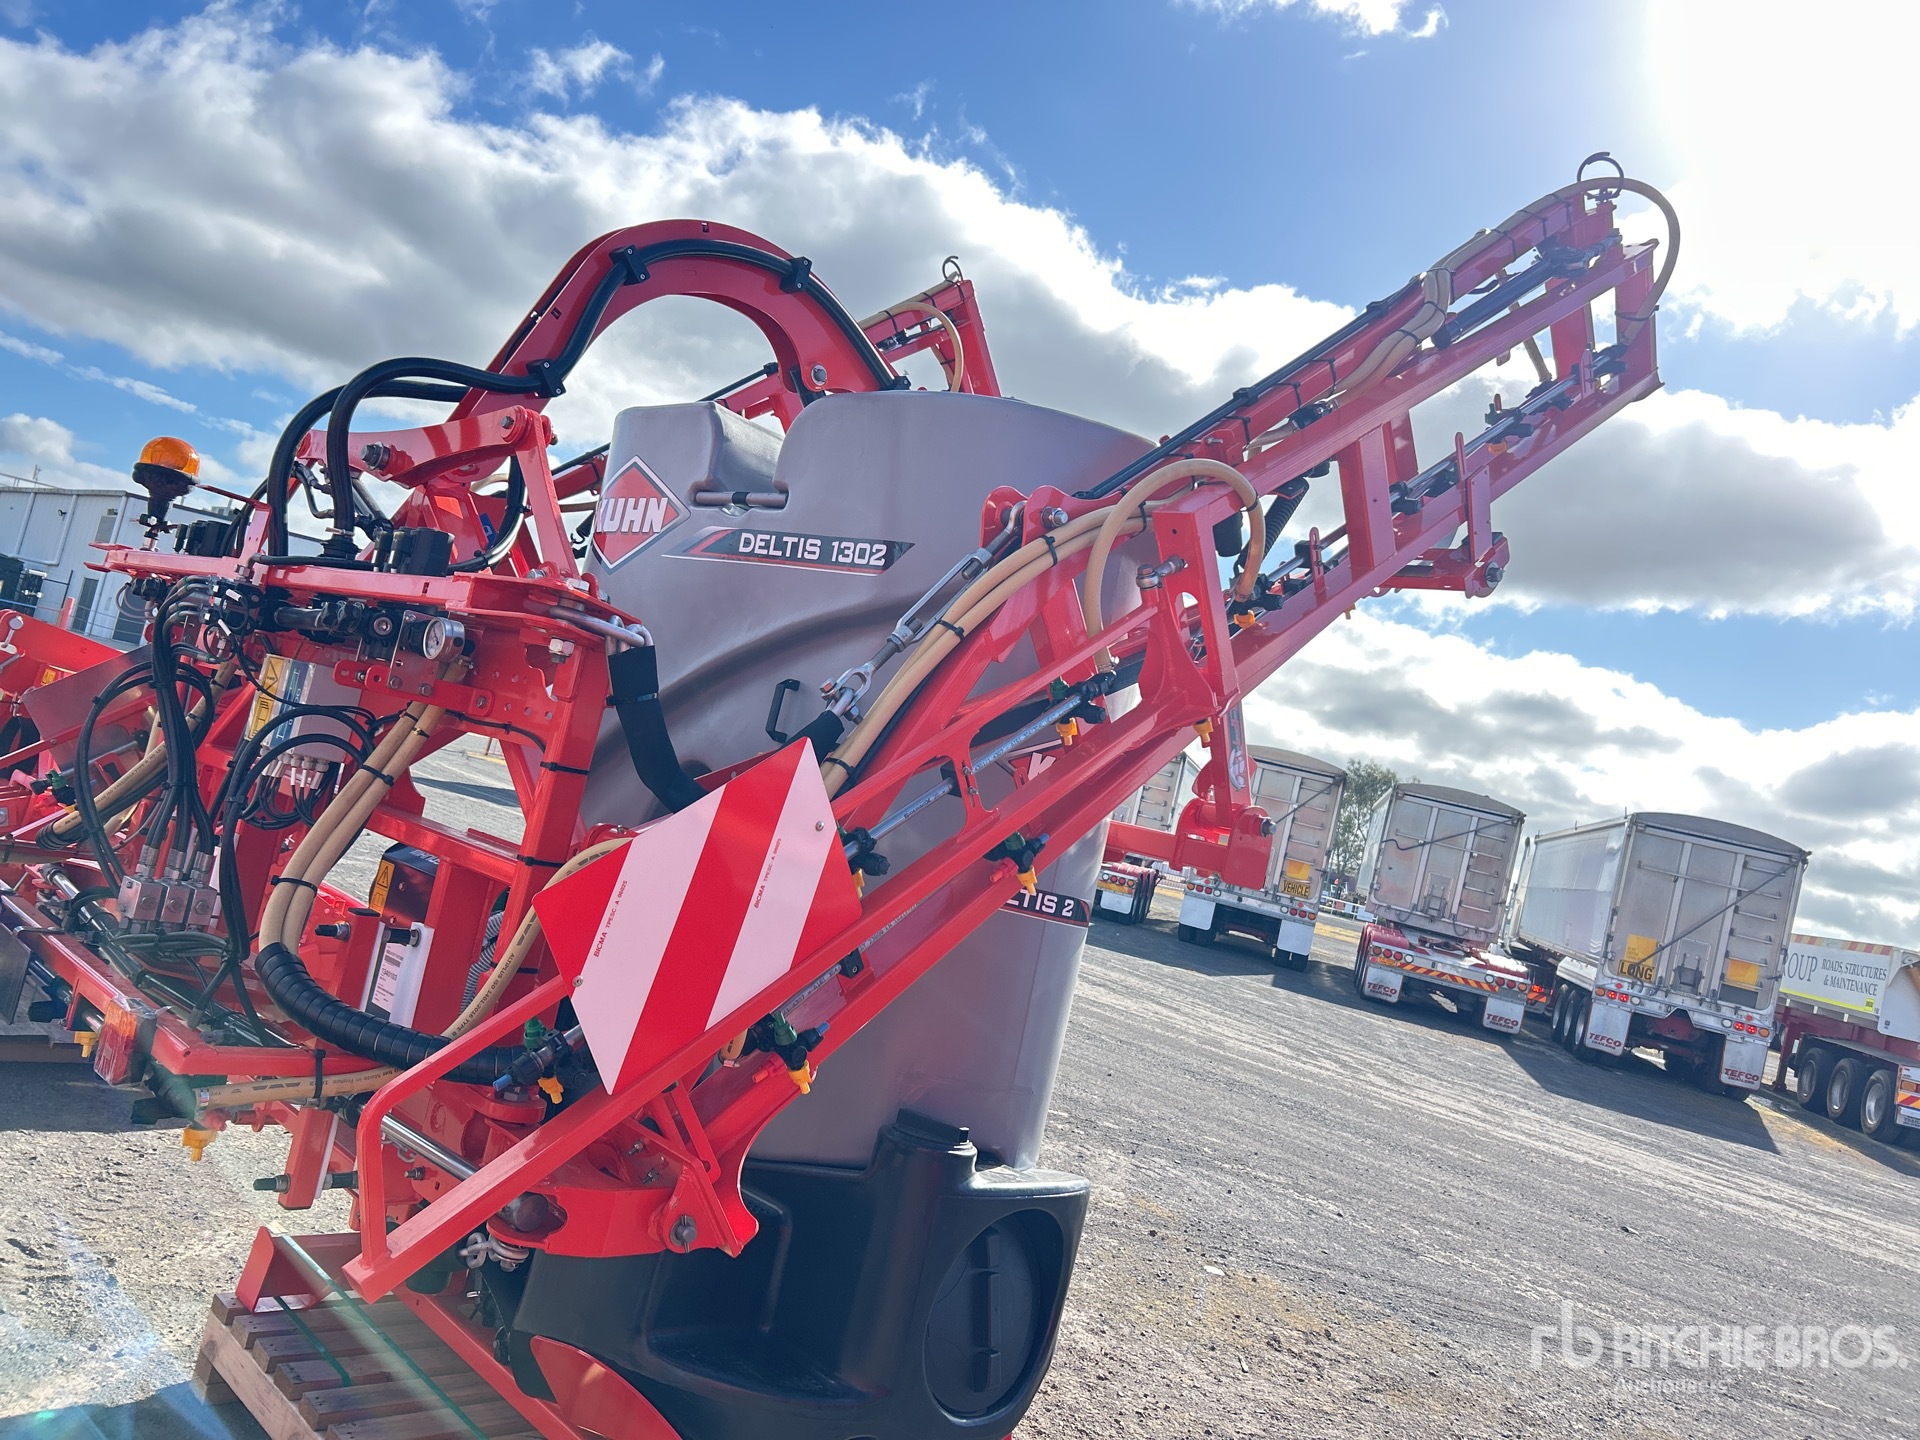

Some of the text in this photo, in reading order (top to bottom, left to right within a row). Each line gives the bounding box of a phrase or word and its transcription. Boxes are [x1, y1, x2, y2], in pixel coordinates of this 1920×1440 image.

[738, 531, 888, 566] DELTIS 1302
[1283, 880, 1309, 898] VEHICLE
[1062, 899, 1075, 917] 2
[593, 931, 608, 958] BICMA
[497, 952, 516, 980] ALTIPLUS
[1619, 961, 1654, 981] LONG
[1844, 962, 1888, 982] STRUCTURES
[1367, 982, 1398, 995] TEFCO
[1829, 975, 1879, 997] MAINTENANCE
[1486, 1013, 1519, 1027] TEFCO
[1589, 1032, 1622, 1048] TEFCO
[1724, 1067, 1760, 1082] TEFCO
